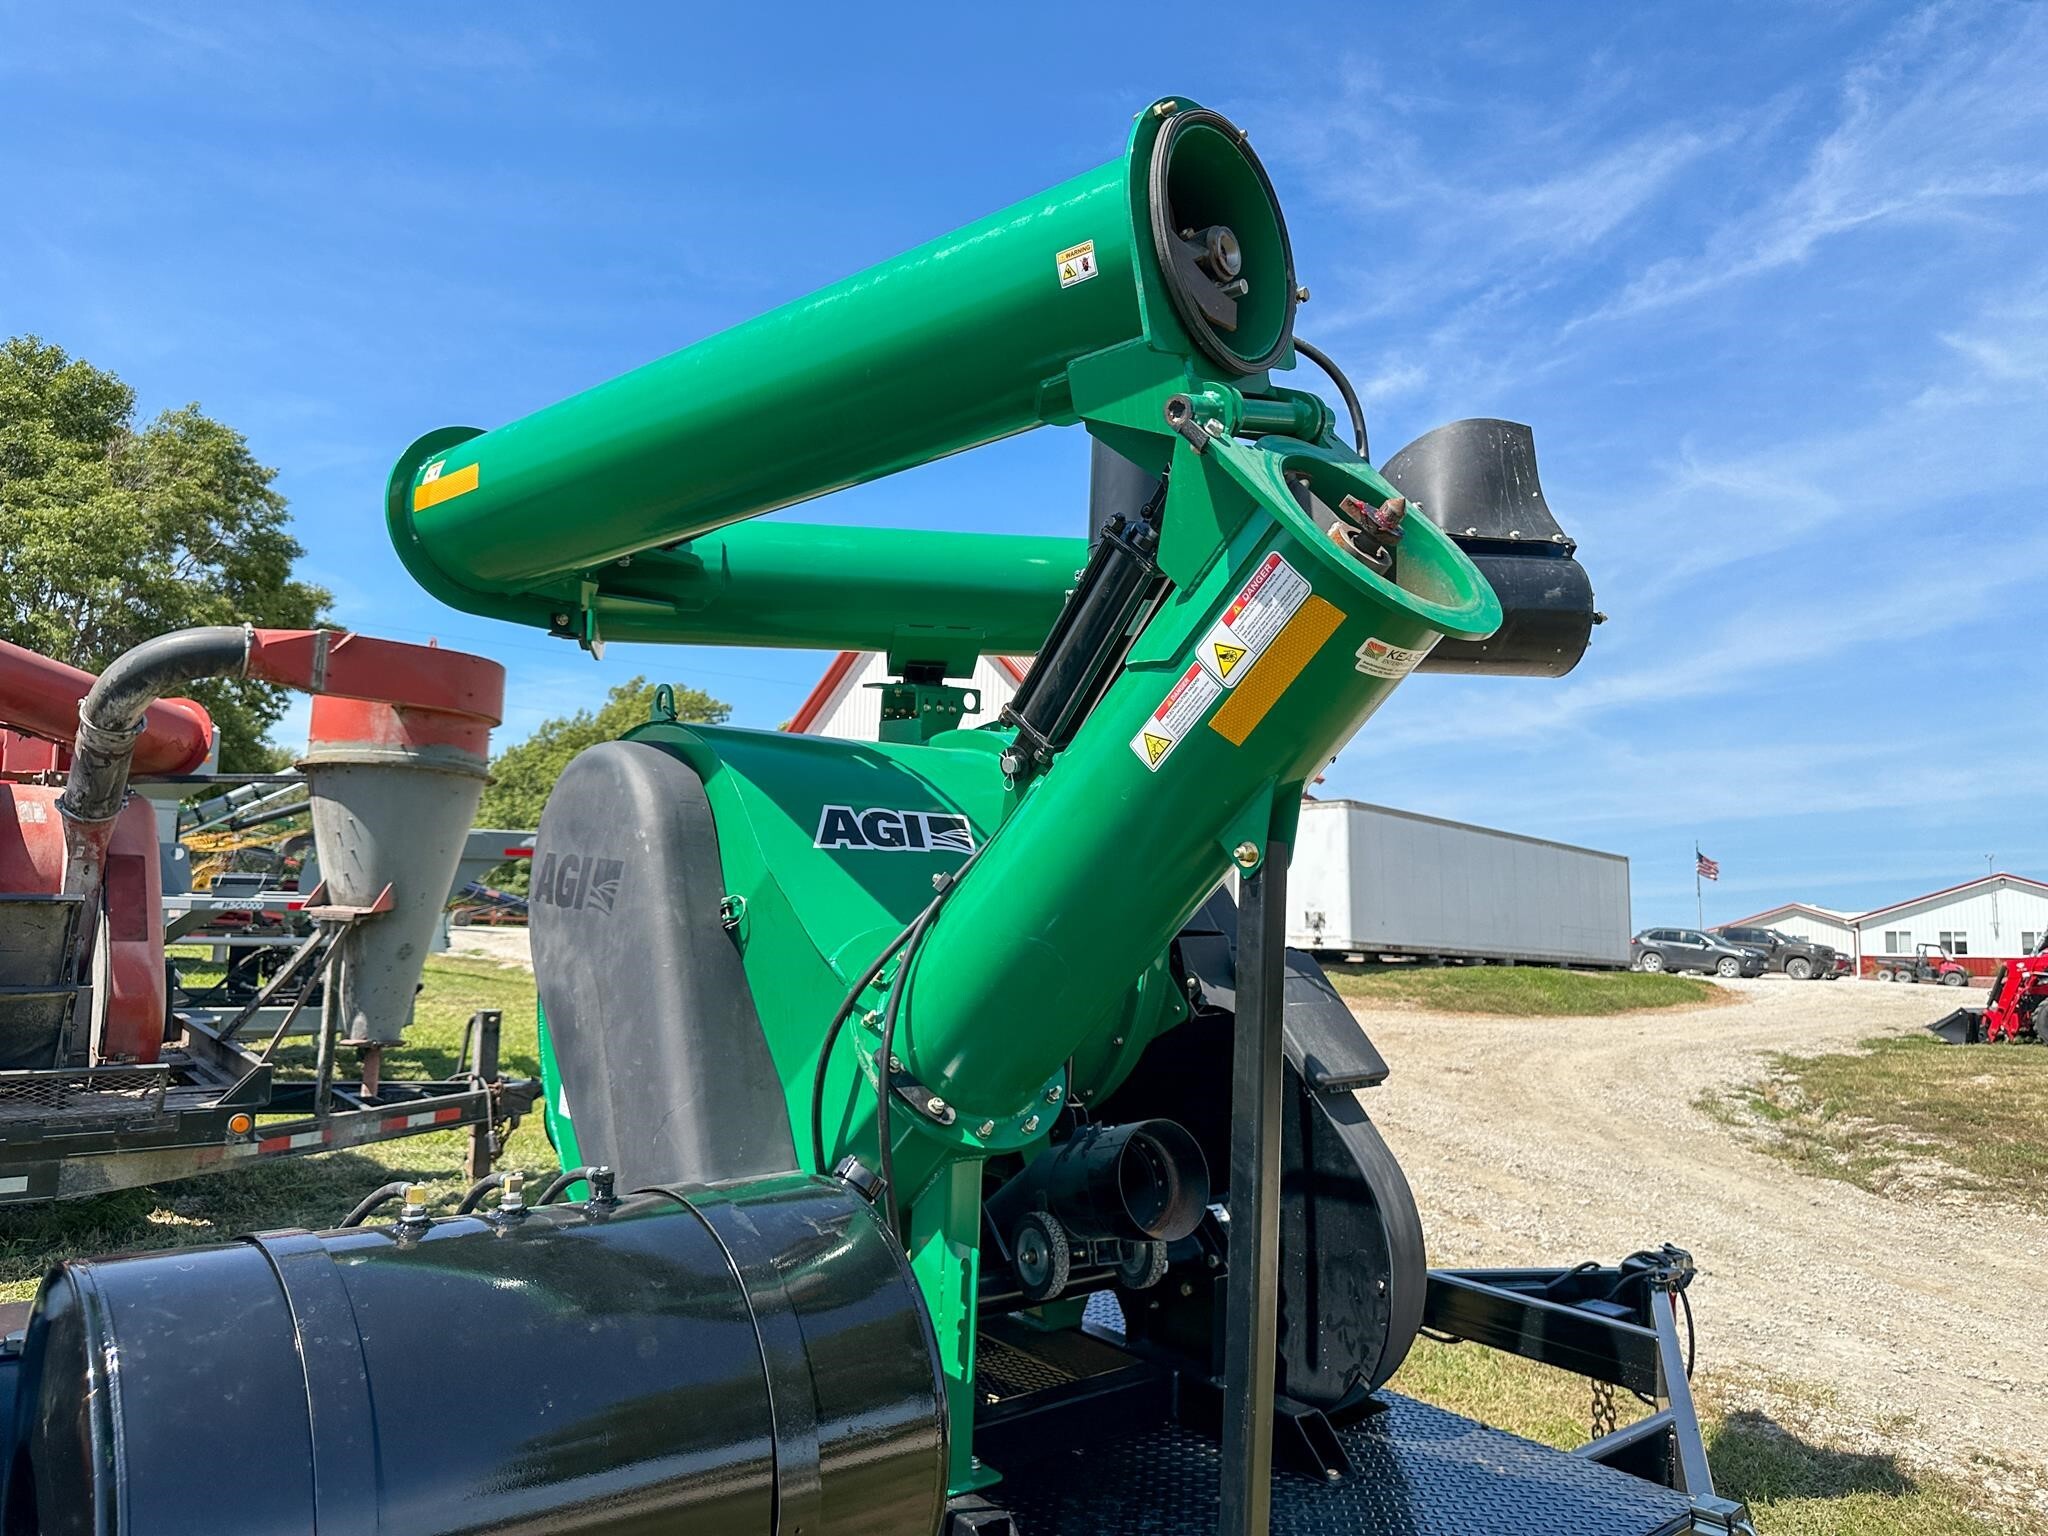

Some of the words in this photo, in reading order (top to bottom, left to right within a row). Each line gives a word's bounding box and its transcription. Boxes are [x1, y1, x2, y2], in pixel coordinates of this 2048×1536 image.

[1065, 244, 1091, 259] WARNING
[1242, 564, 1273, 602] DANGER
[1170, 677, 1190, 701] DANGER
[817, 806, 928, 851] AGI
[535, 852, 593, 910] AGI
